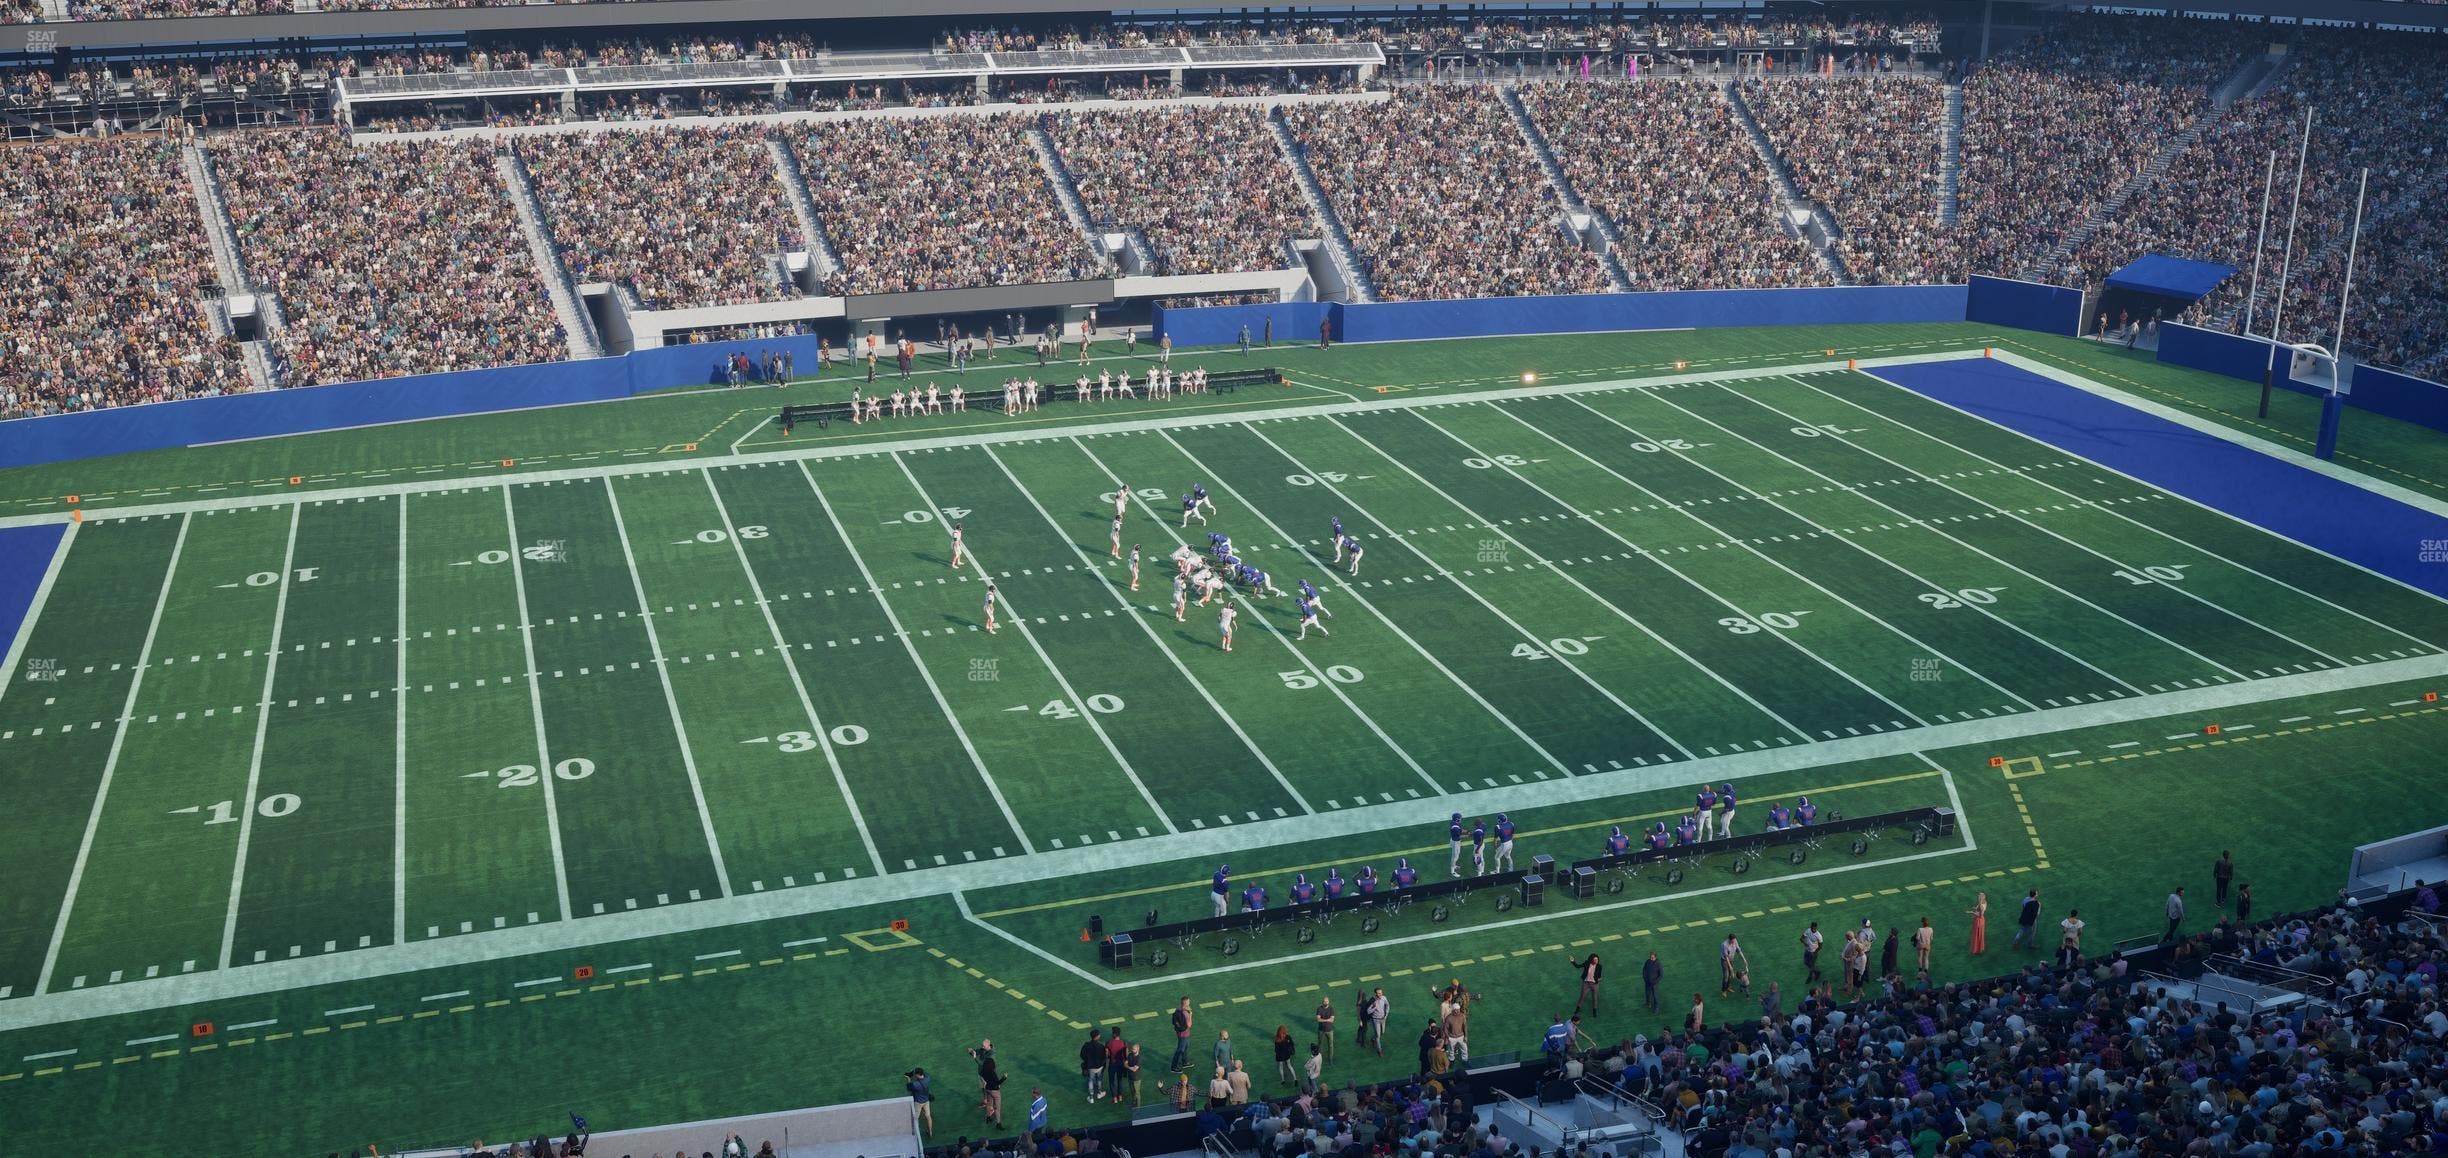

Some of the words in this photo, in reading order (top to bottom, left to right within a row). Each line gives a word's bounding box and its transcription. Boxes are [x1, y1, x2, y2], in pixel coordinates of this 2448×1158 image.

[1918, 588, 1998, 610] 20
[1718, 612, 1799, 635] 30
[1511, 637, 1589, 661] 40
[1278, 664, 1365, 690] 50
[1038, 693, 1125, 720] 40
[776, 724, 869, 753] 30
[497, 757, 596, 789] 20
[203, 793, 302, 826] 10
